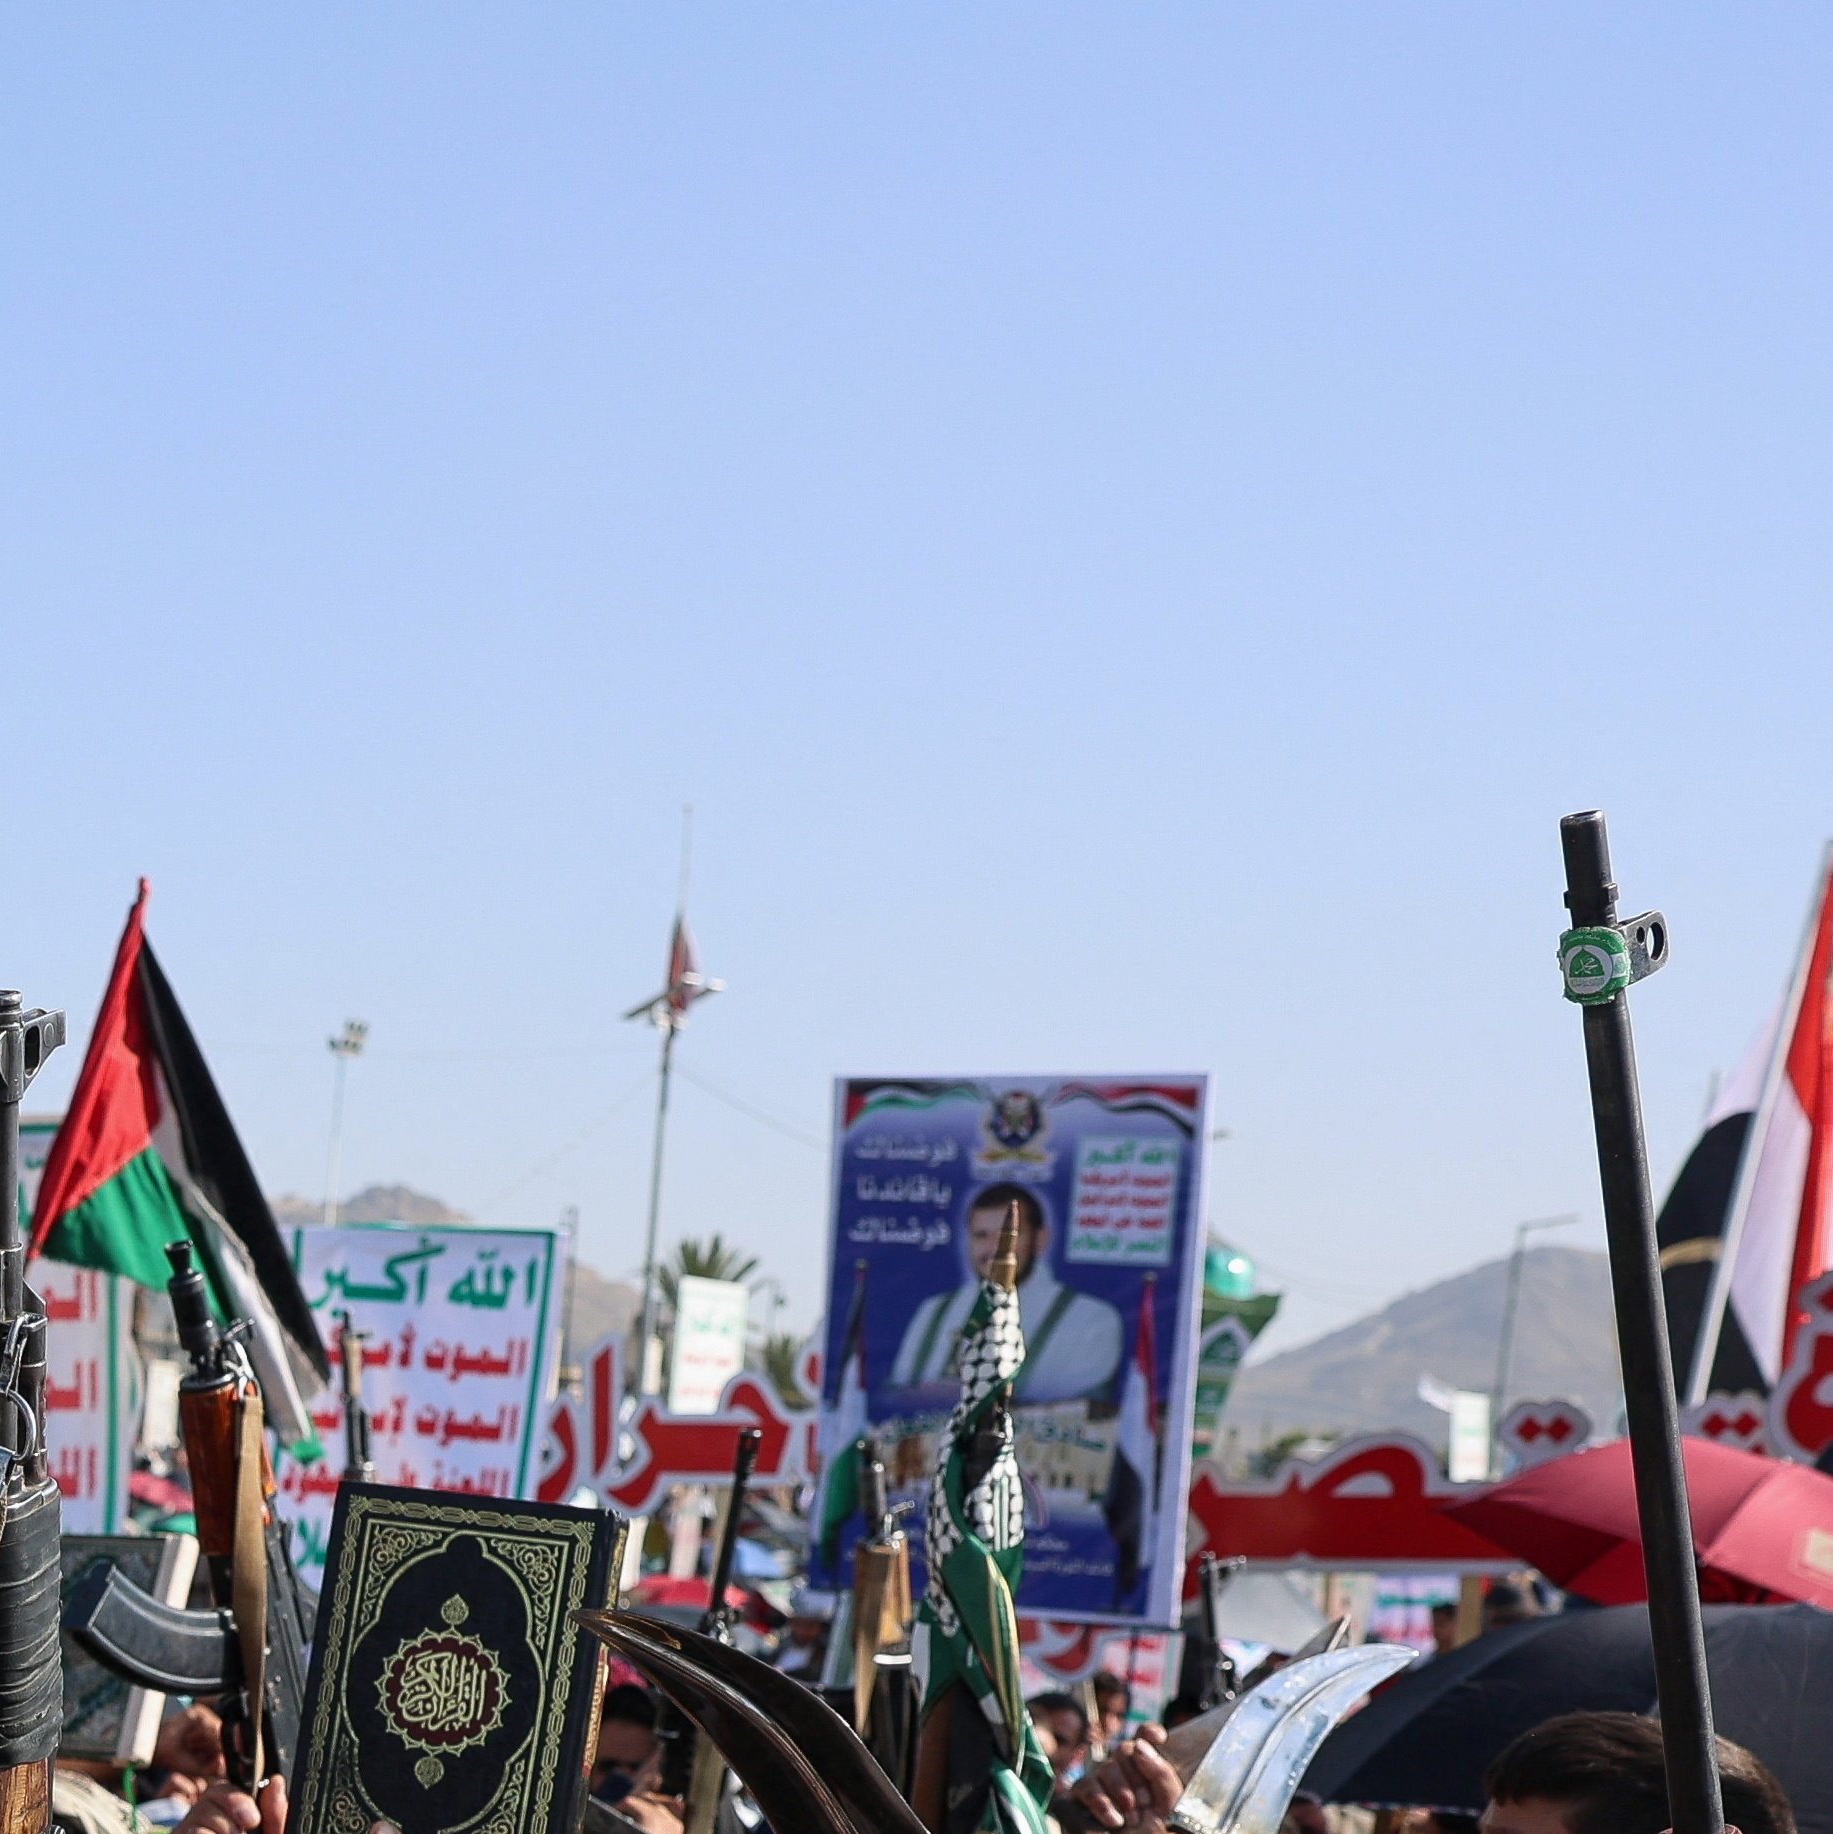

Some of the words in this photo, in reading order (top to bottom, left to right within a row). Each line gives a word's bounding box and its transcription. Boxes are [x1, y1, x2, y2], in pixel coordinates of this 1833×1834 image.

[308, 1236, 445, 1319] أكبر
[448, 1249, 537, 1310] الله
[425, 1336, 529, 1382] الموت
[416, 1403, 519, 1447] الموت
